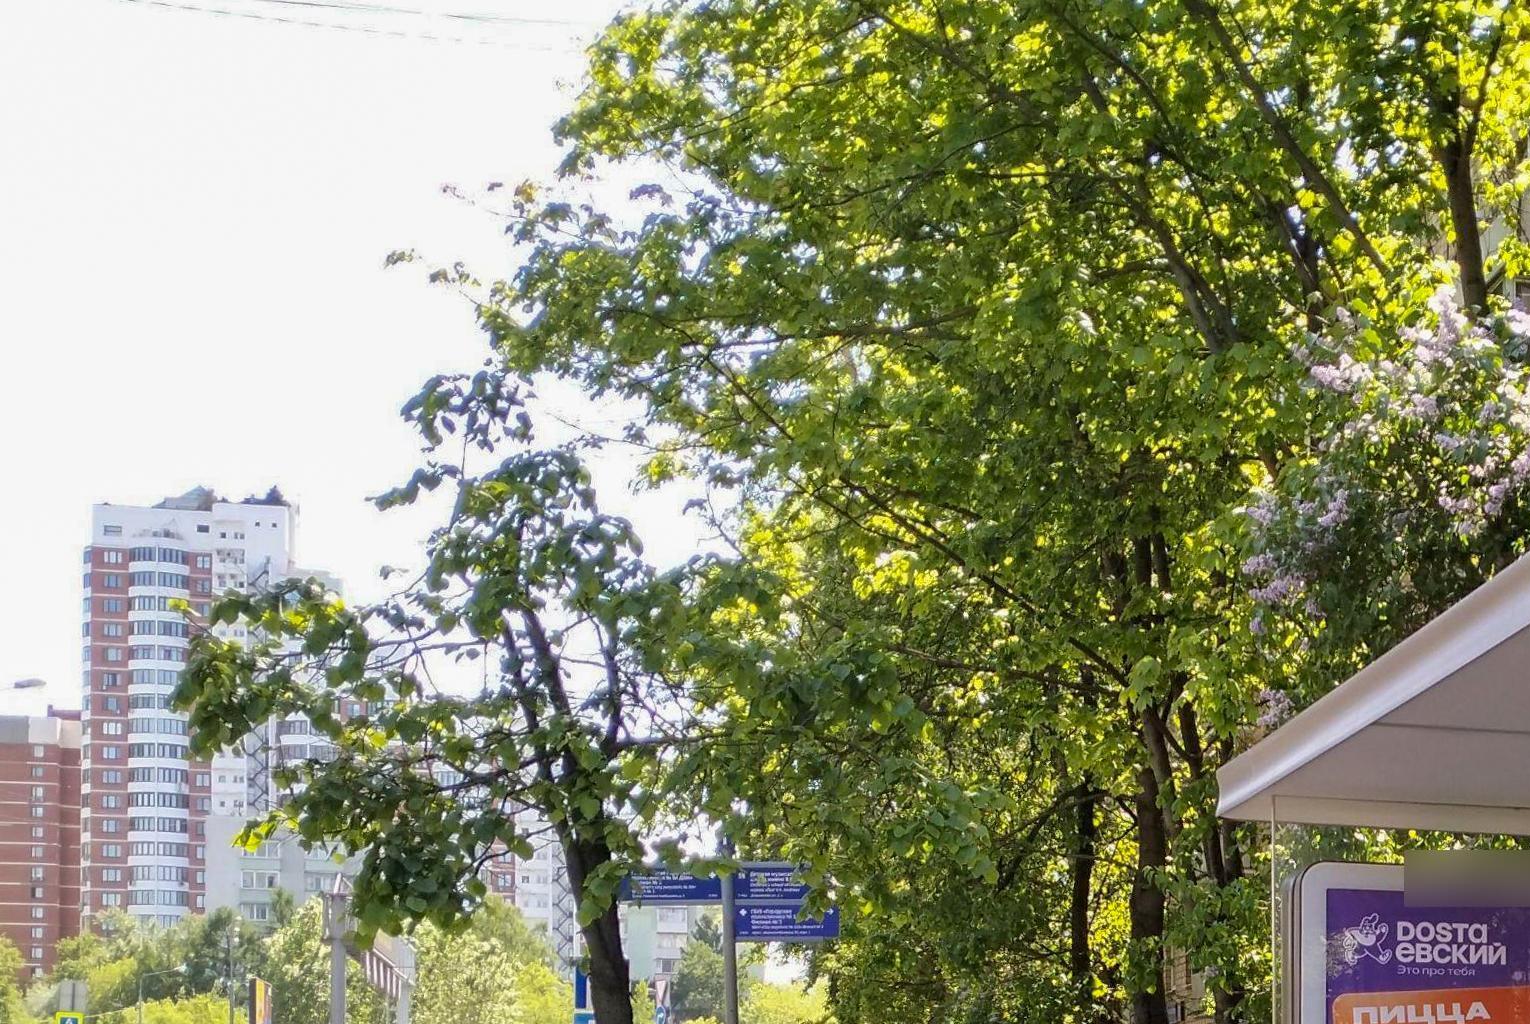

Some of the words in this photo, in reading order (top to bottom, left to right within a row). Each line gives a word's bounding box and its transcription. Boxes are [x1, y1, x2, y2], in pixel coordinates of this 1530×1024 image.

[1397, 964, 1420, 975] Это
[1422, 966, 1446, 977] про
[1448, 966, 1476, 977] тебя
